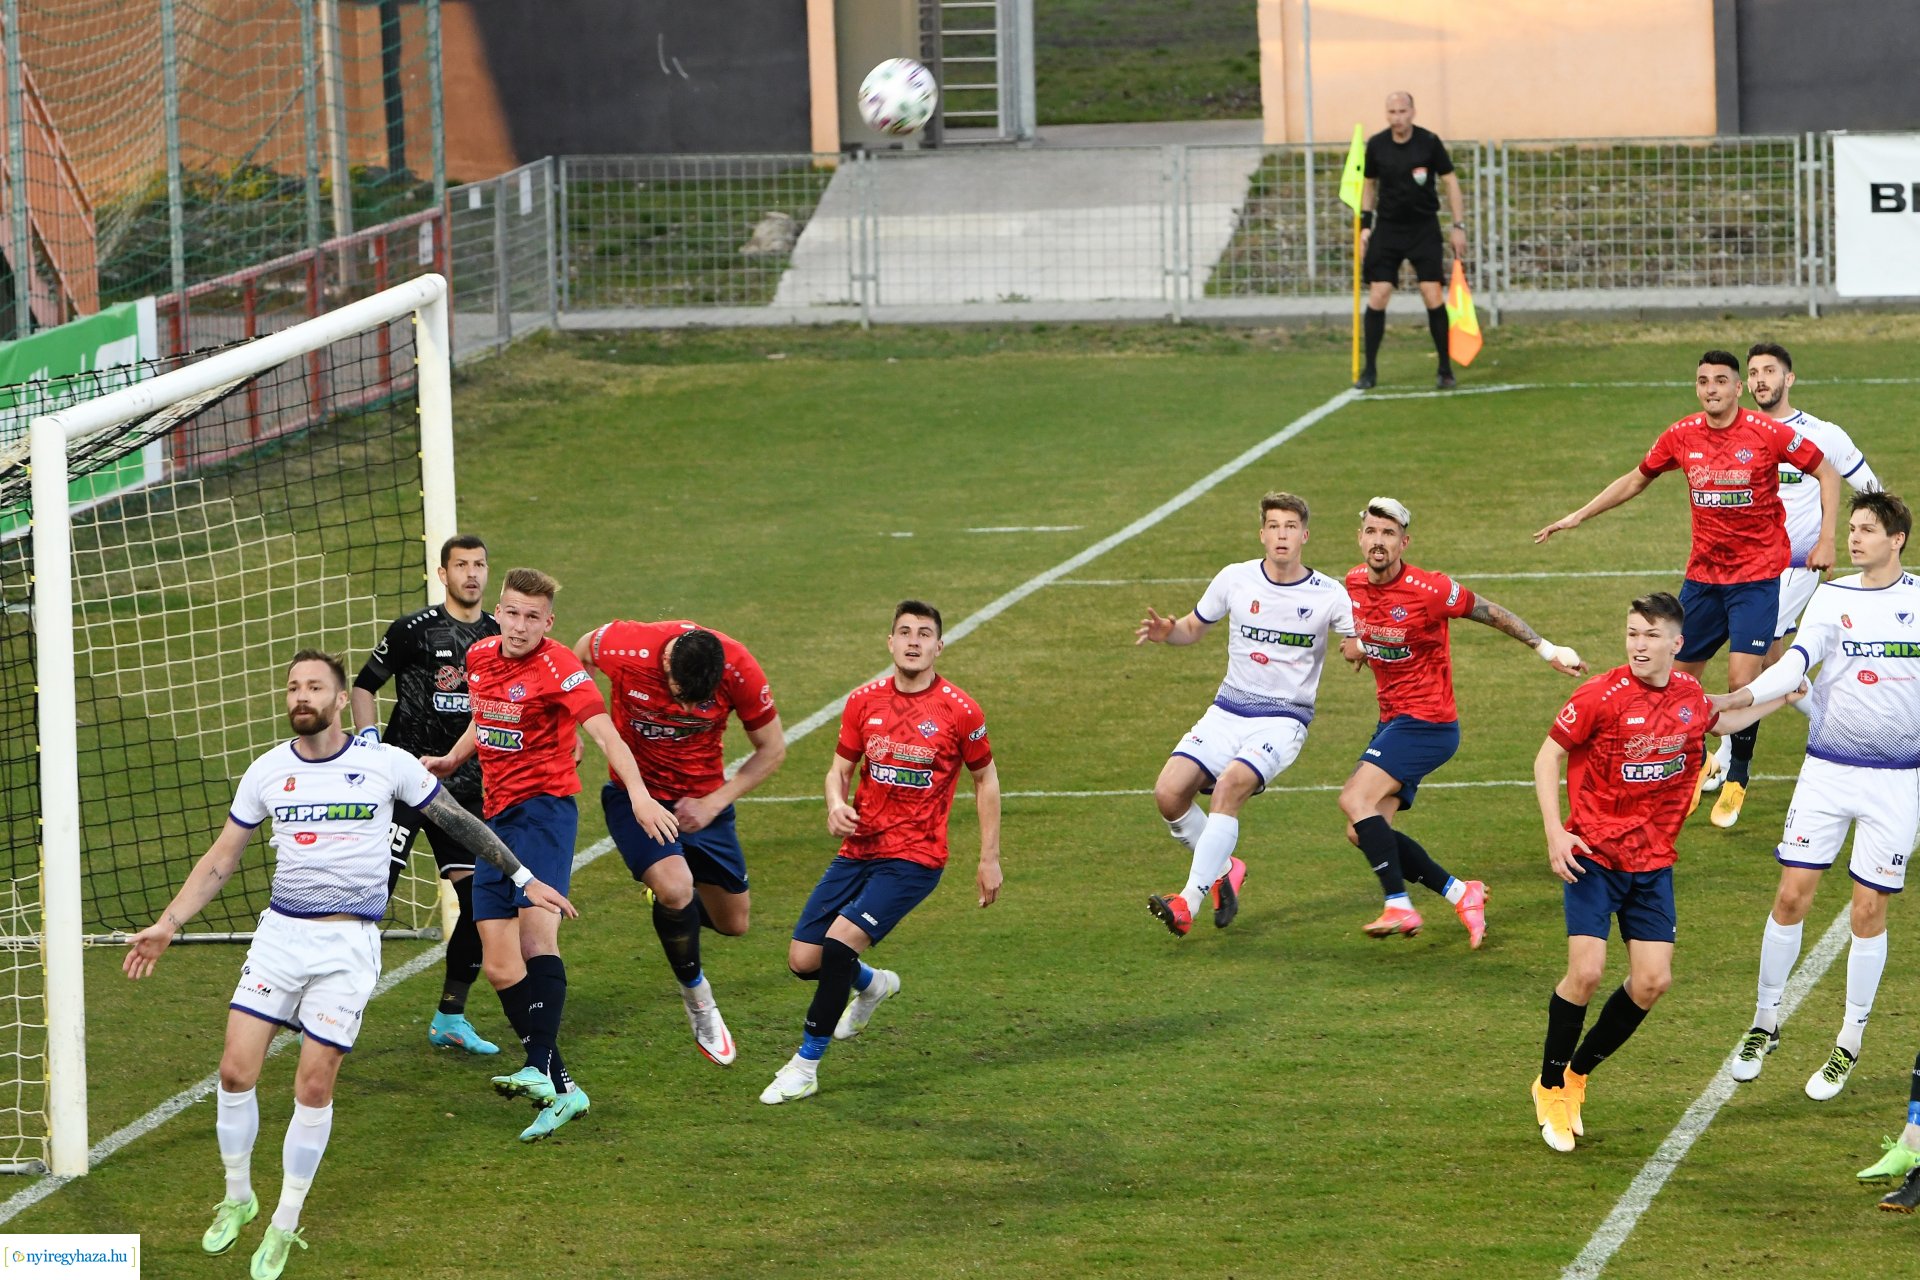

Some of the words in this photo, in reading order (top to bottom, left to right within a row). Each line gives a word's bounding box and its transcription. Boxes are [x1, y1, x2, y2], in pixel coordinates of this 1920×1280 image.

[1751, 639, 1765, 648] JAKO
[435, 649, 453, 658] JAKO
[628, 689, 650, 701] JAKO
[1626, 716, 1646, 725] JAKO
